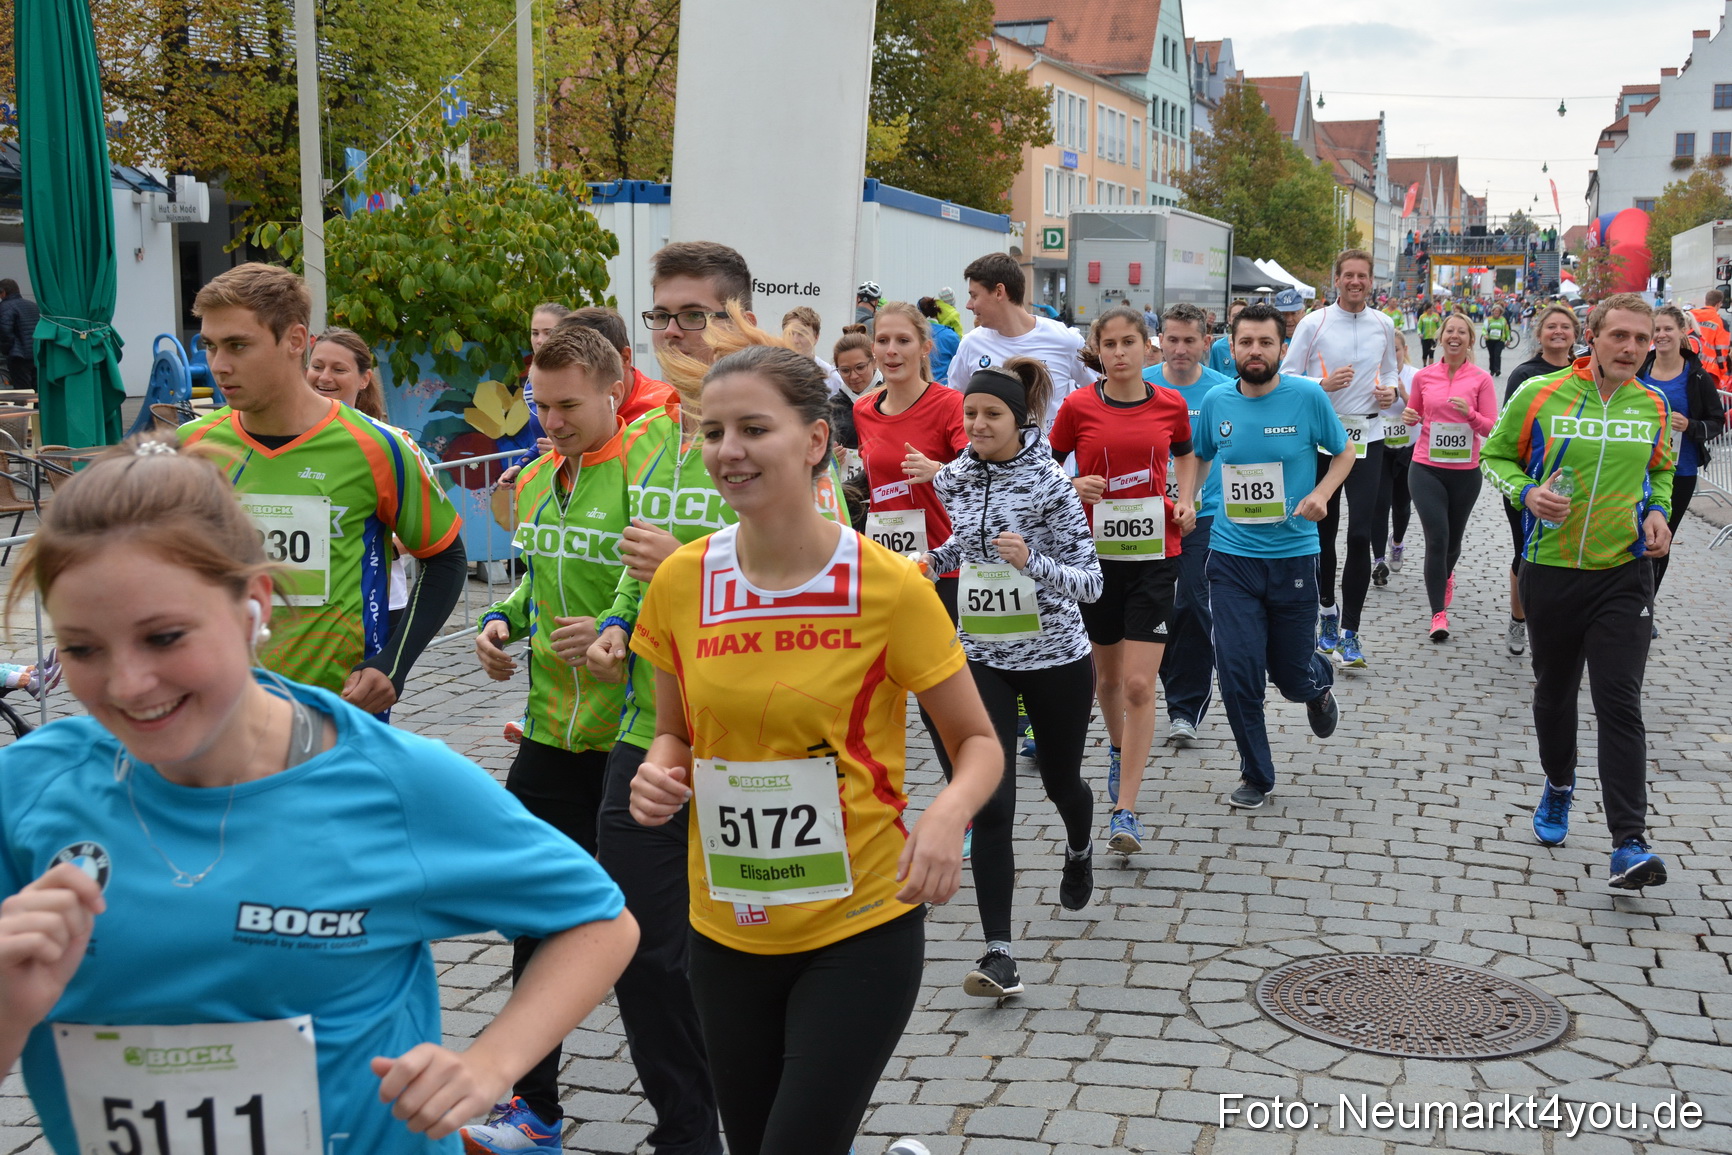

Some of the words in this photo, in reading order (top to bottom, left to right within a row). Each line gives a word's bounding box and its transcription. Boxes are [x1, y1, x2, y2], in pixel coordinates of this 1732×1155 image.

[159, 204, 170, 213] Hut
[180, 204, 196, 213] Mode
[1046, 231, 1061, 247] D
[1469, 256, 1489, 265] ZIEL
[751, 278, 821, 297] fsport.de
[1263, 425, 1298, 435] BOCK
[1551, 415, 1655, 444] BOCK
[1435, 434, 1467, 448] 5093
[847, 465, 862, 480] 51
[1121, 475, 1139, 486] DEHN
[881, 485, 899, 497] DEHN
[1231, 481, 1275, 501] 5183
[252, 505, 294, 515] BOCK
[1244, 506, 1262, 514] Khalil
[1103, 518, 1154, 538] 5063
[258, 529, 311, 563] 30
[511, 523, 626, 566] BOCK
[873, 531, 917, 553] 5062
[1121, 543, 1138, 551] Sara
[984, 571, 1010, 579] BOCK
[968, 588, 1021, 612] 5211
[636, 622, 660, 648] egl.de
[696, 632, 763, 659] MAX
[775, 624, 861, 652] BÖGL
[740, 775, 791, 788] BOCK
[719, 804, 821, 849] 5172
[740, 863, 806, 881] Elisabeth
[236, 901, 371, 938] BOCK
[280, 938, 294, 949] by
[297, 940, 328, 949] smart
[145, 1044, 236, 1068] BOCK
[102, 1094, 266, 1155] 5111
